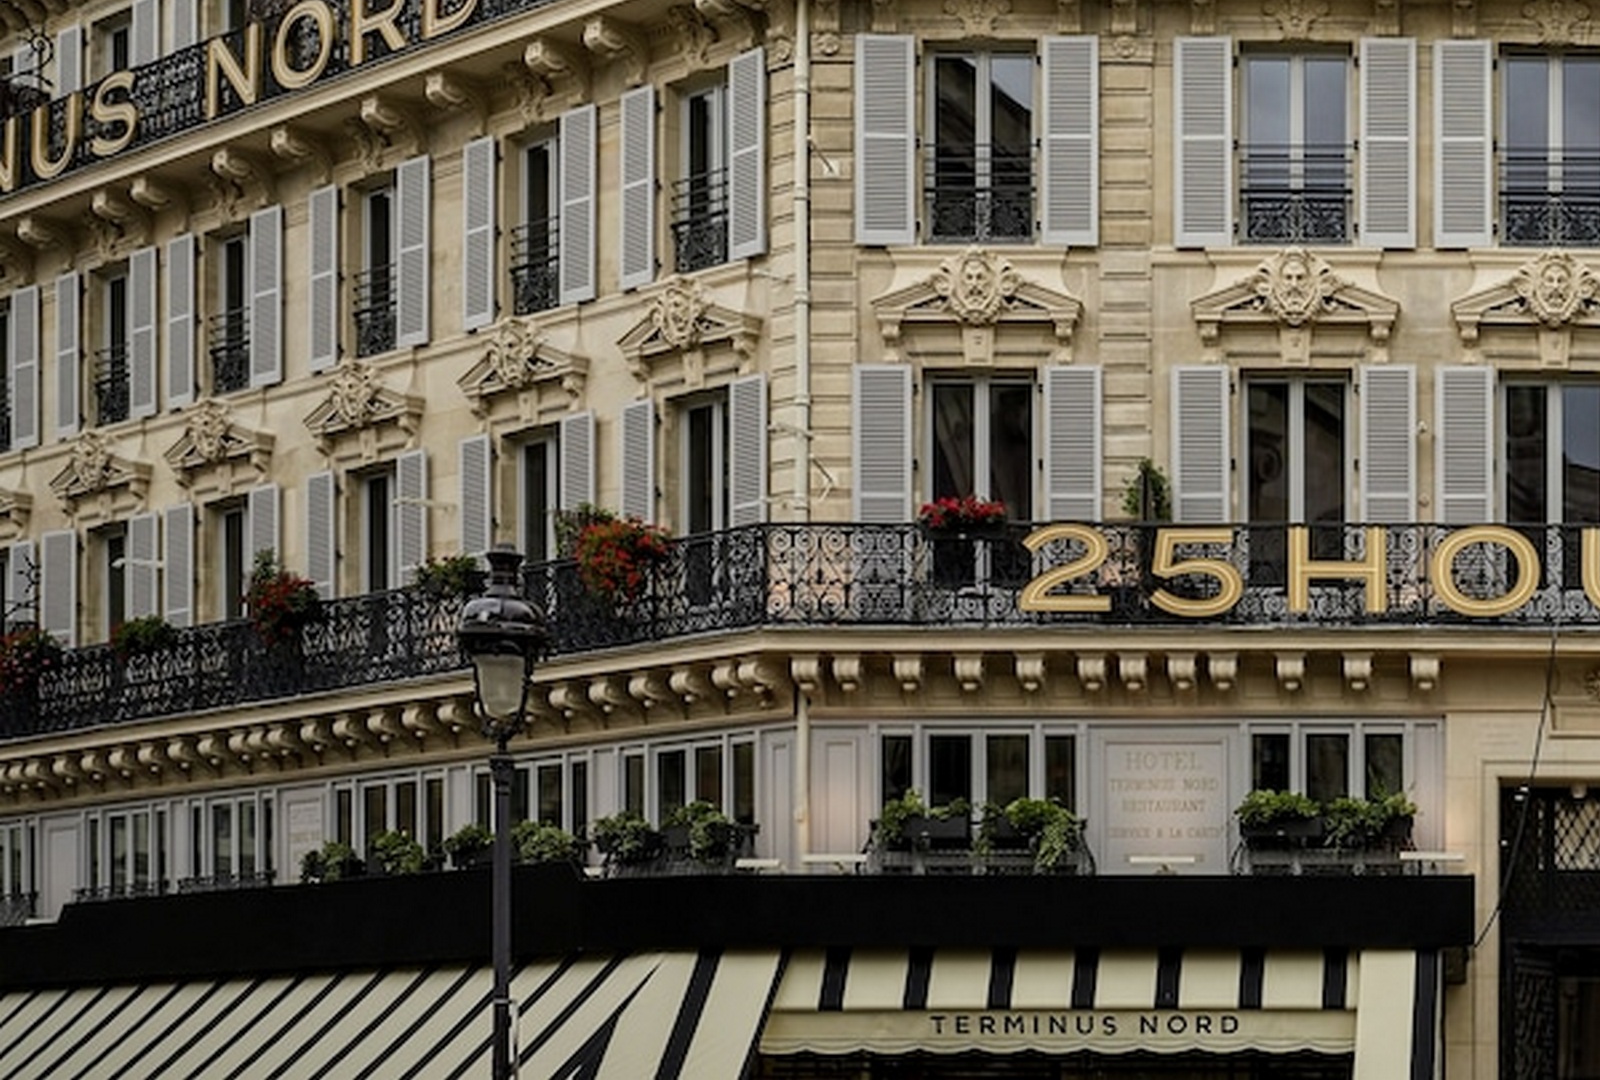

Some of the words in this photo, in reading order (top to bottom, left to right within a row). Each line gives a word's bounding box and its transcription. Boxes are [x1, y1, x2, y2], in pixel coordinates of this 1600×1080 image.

[1125, 751, 1202, 771] HOTEL
[930, 1016, 1118, 1035] TERMINUS
[1139, 1015, 1239, 1034] NORD
